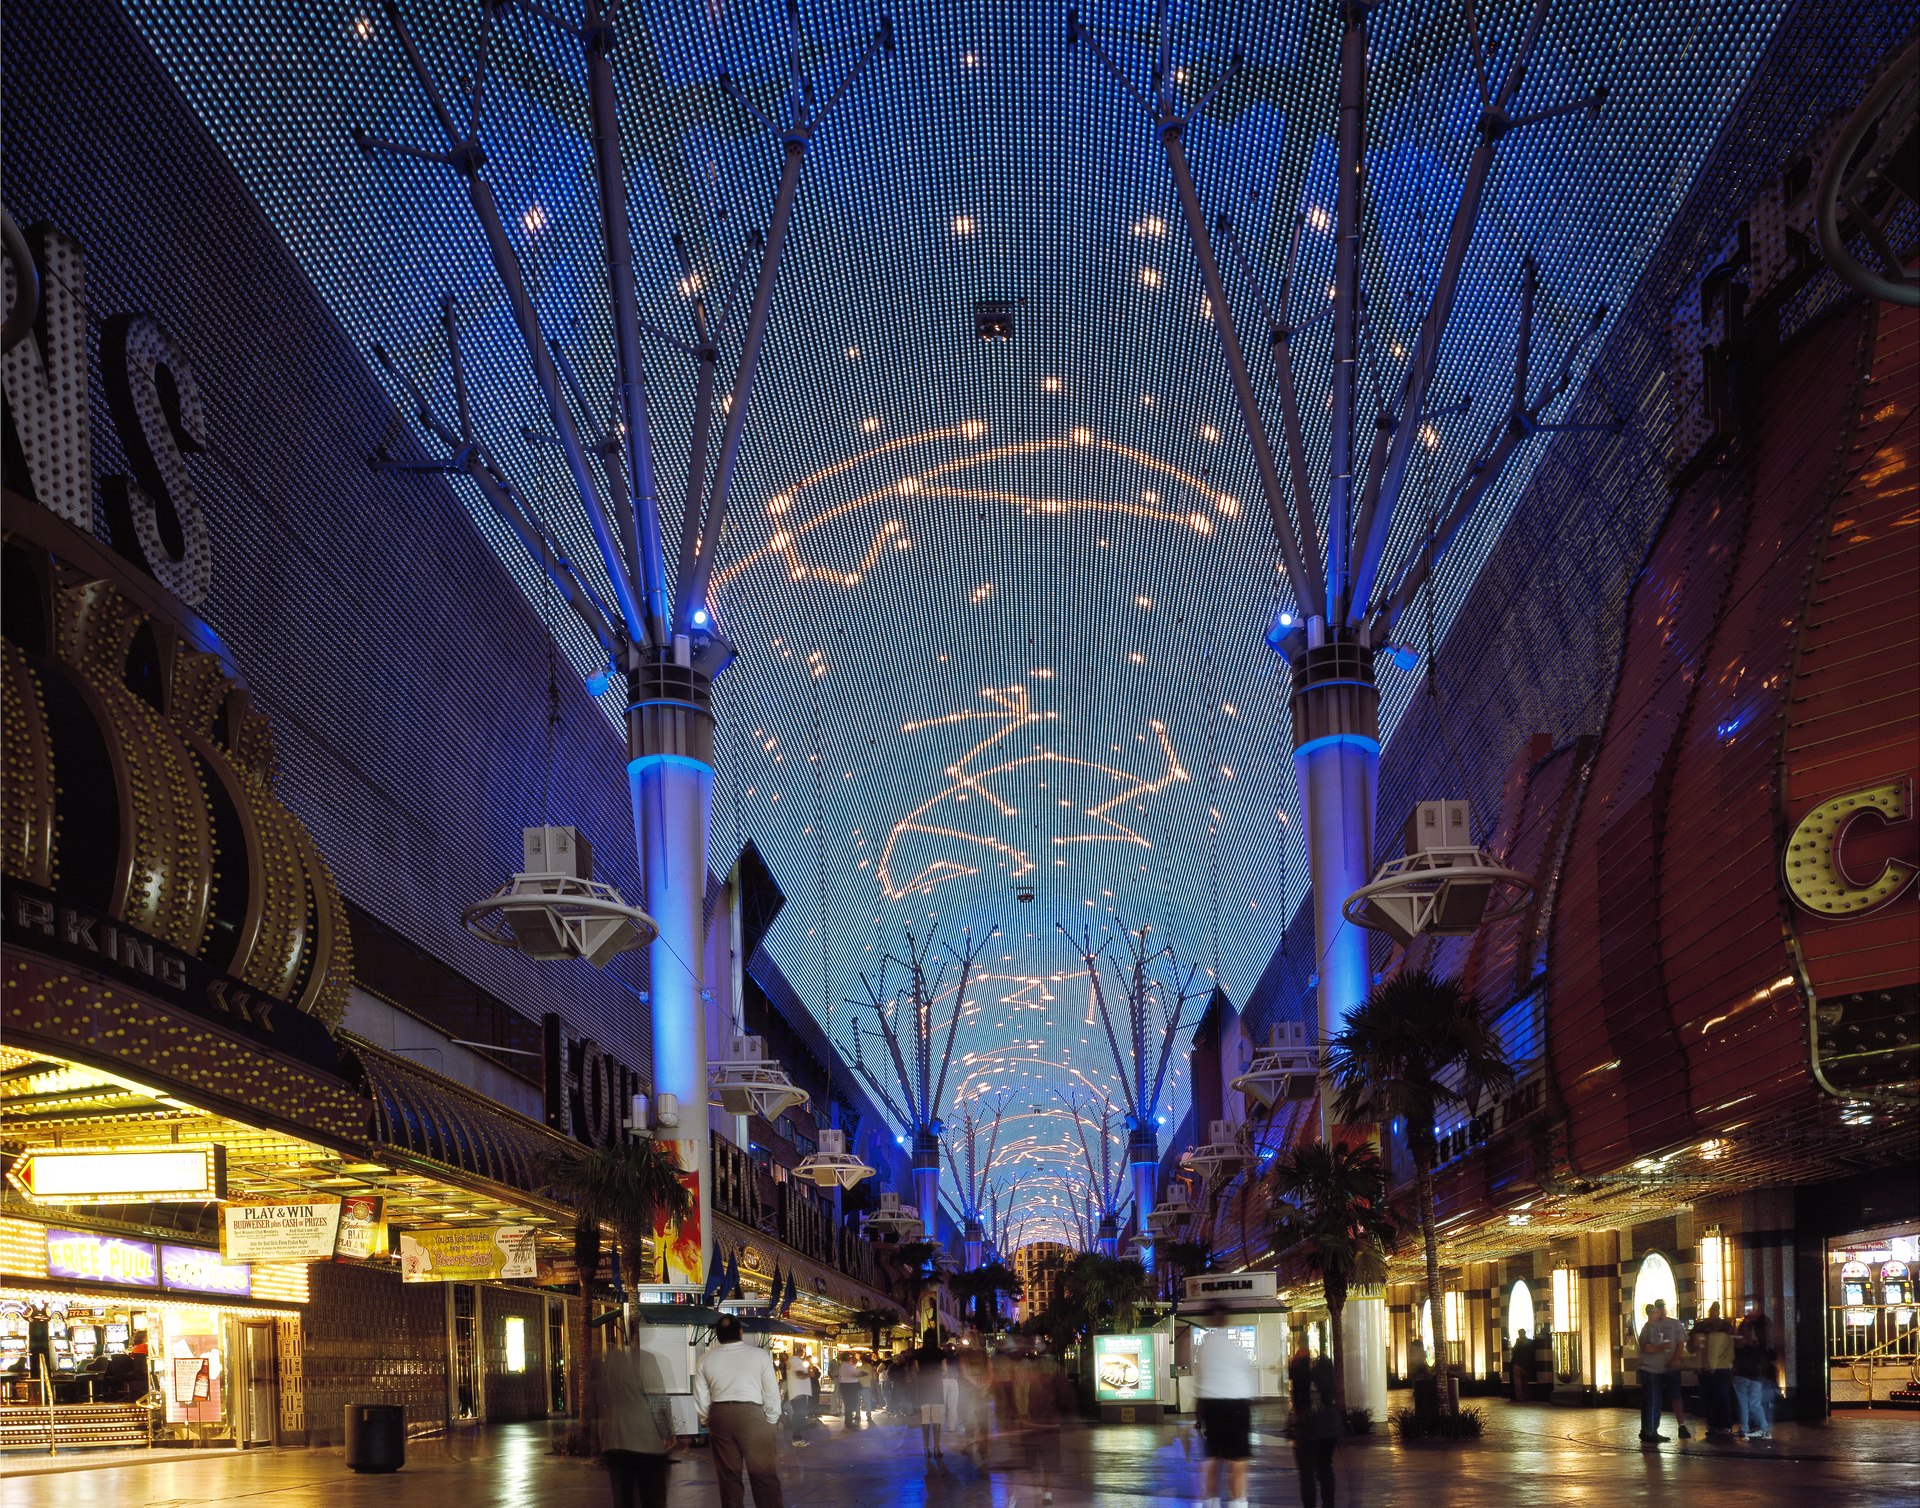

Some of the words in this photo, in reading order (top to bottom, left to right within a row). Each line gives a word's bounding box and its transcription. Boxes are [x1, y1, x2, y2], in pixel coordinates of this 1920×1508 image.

[1, 892, 187, 992] RKING
[245, 1208, 275, 1219] PLAY
[277, 1208, 285, 1217] &
[286, 1206, 313, 1218] WIN
[234, 1220, 270, 1229] BUDWEISER
[282, 1219, 298, 1227] CASH
[305, 1217, 328, 1226] PRIZES
[337, 1238, 352, 1247] PLAY
[434, 1235, 445, 1244] You
[454, 1234, 465, 1244] just
[466, 1232, 490, 1242] minutes
[49, 1241, 104, 1278] FREE
[110, 1246, 155, 1280] PULL
[1202, 1280, 1253, 1291] FUJIFILM
